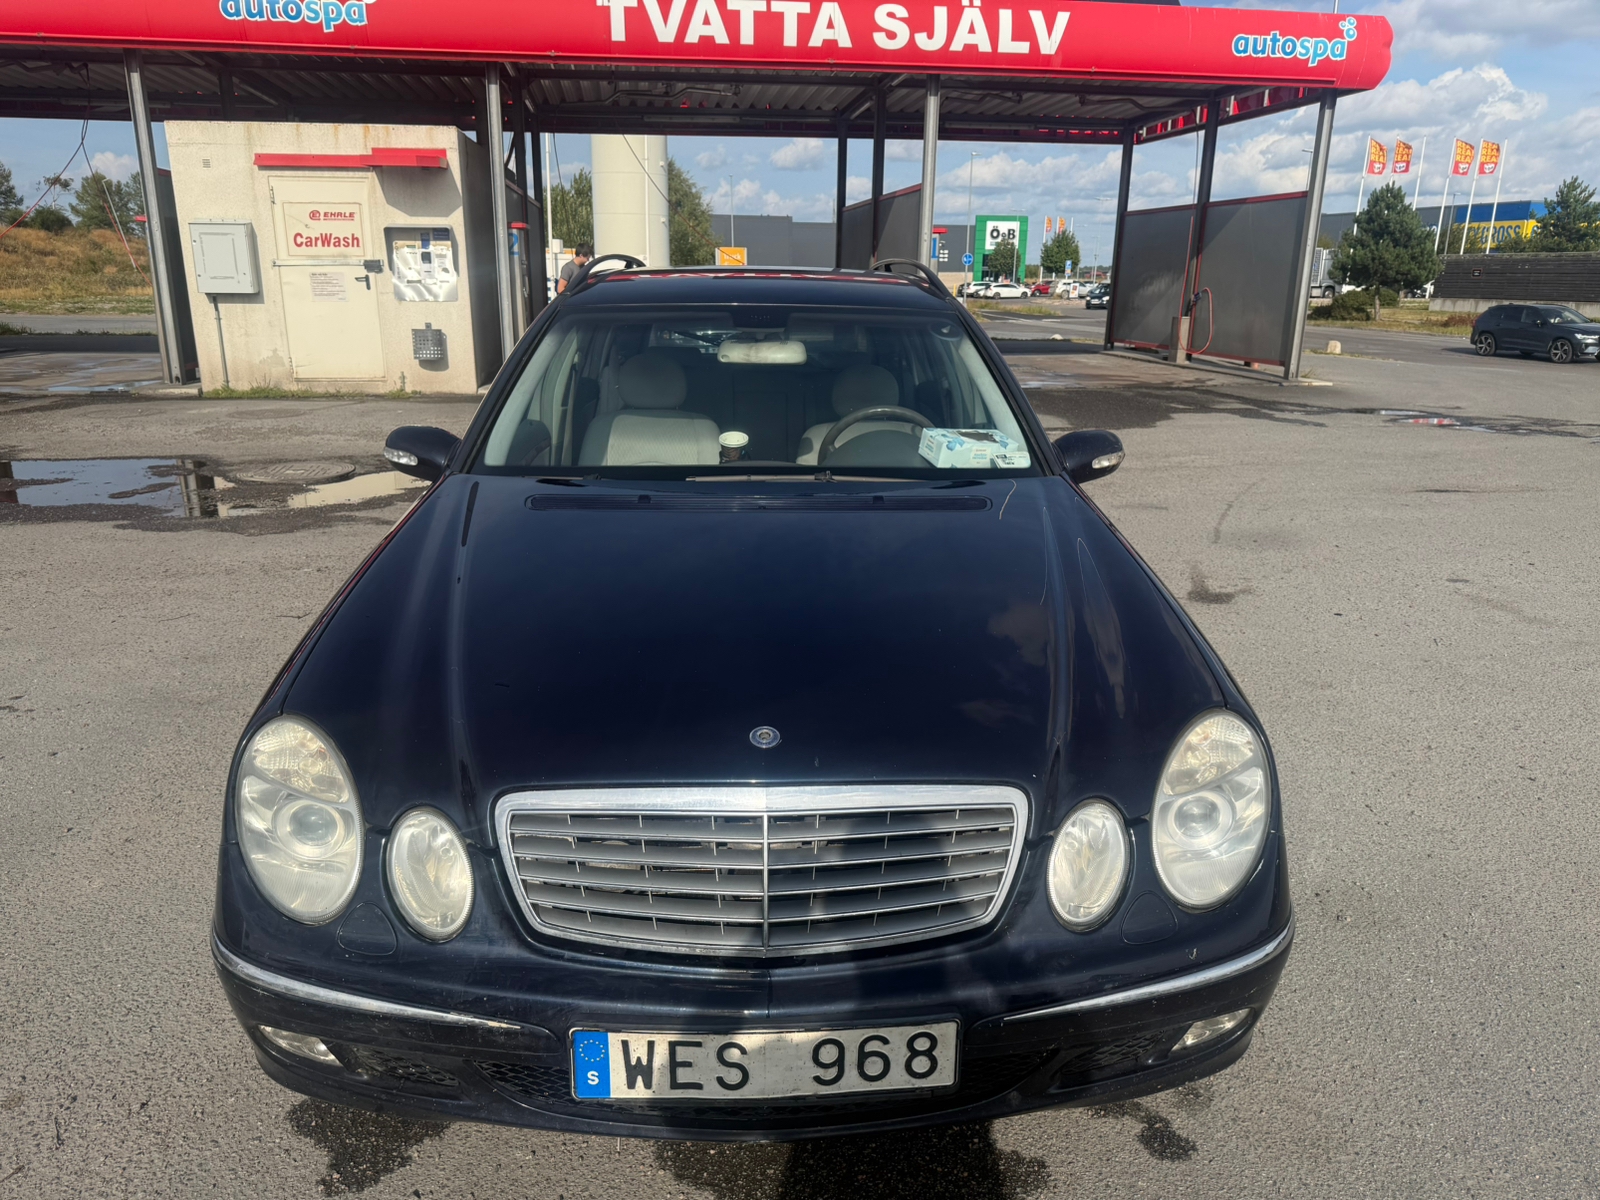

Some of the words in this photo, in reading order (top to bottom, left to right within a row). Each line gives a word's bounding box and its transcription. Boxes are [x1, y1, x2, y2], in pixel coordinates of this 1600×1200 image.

[219, 0, 368, 33] autospa
[872, 0, 1071, 55] SJÄLV
[1232, 30, 1348, 67] autospa
[293, 232, 360, 248] CarWash
[990, 225, 1016, 240] ÖoB
[621, 1038, 750, 1091] WES
[812, 1031, 939, 1086] 968
[587, 1070, 600, 1086] S
